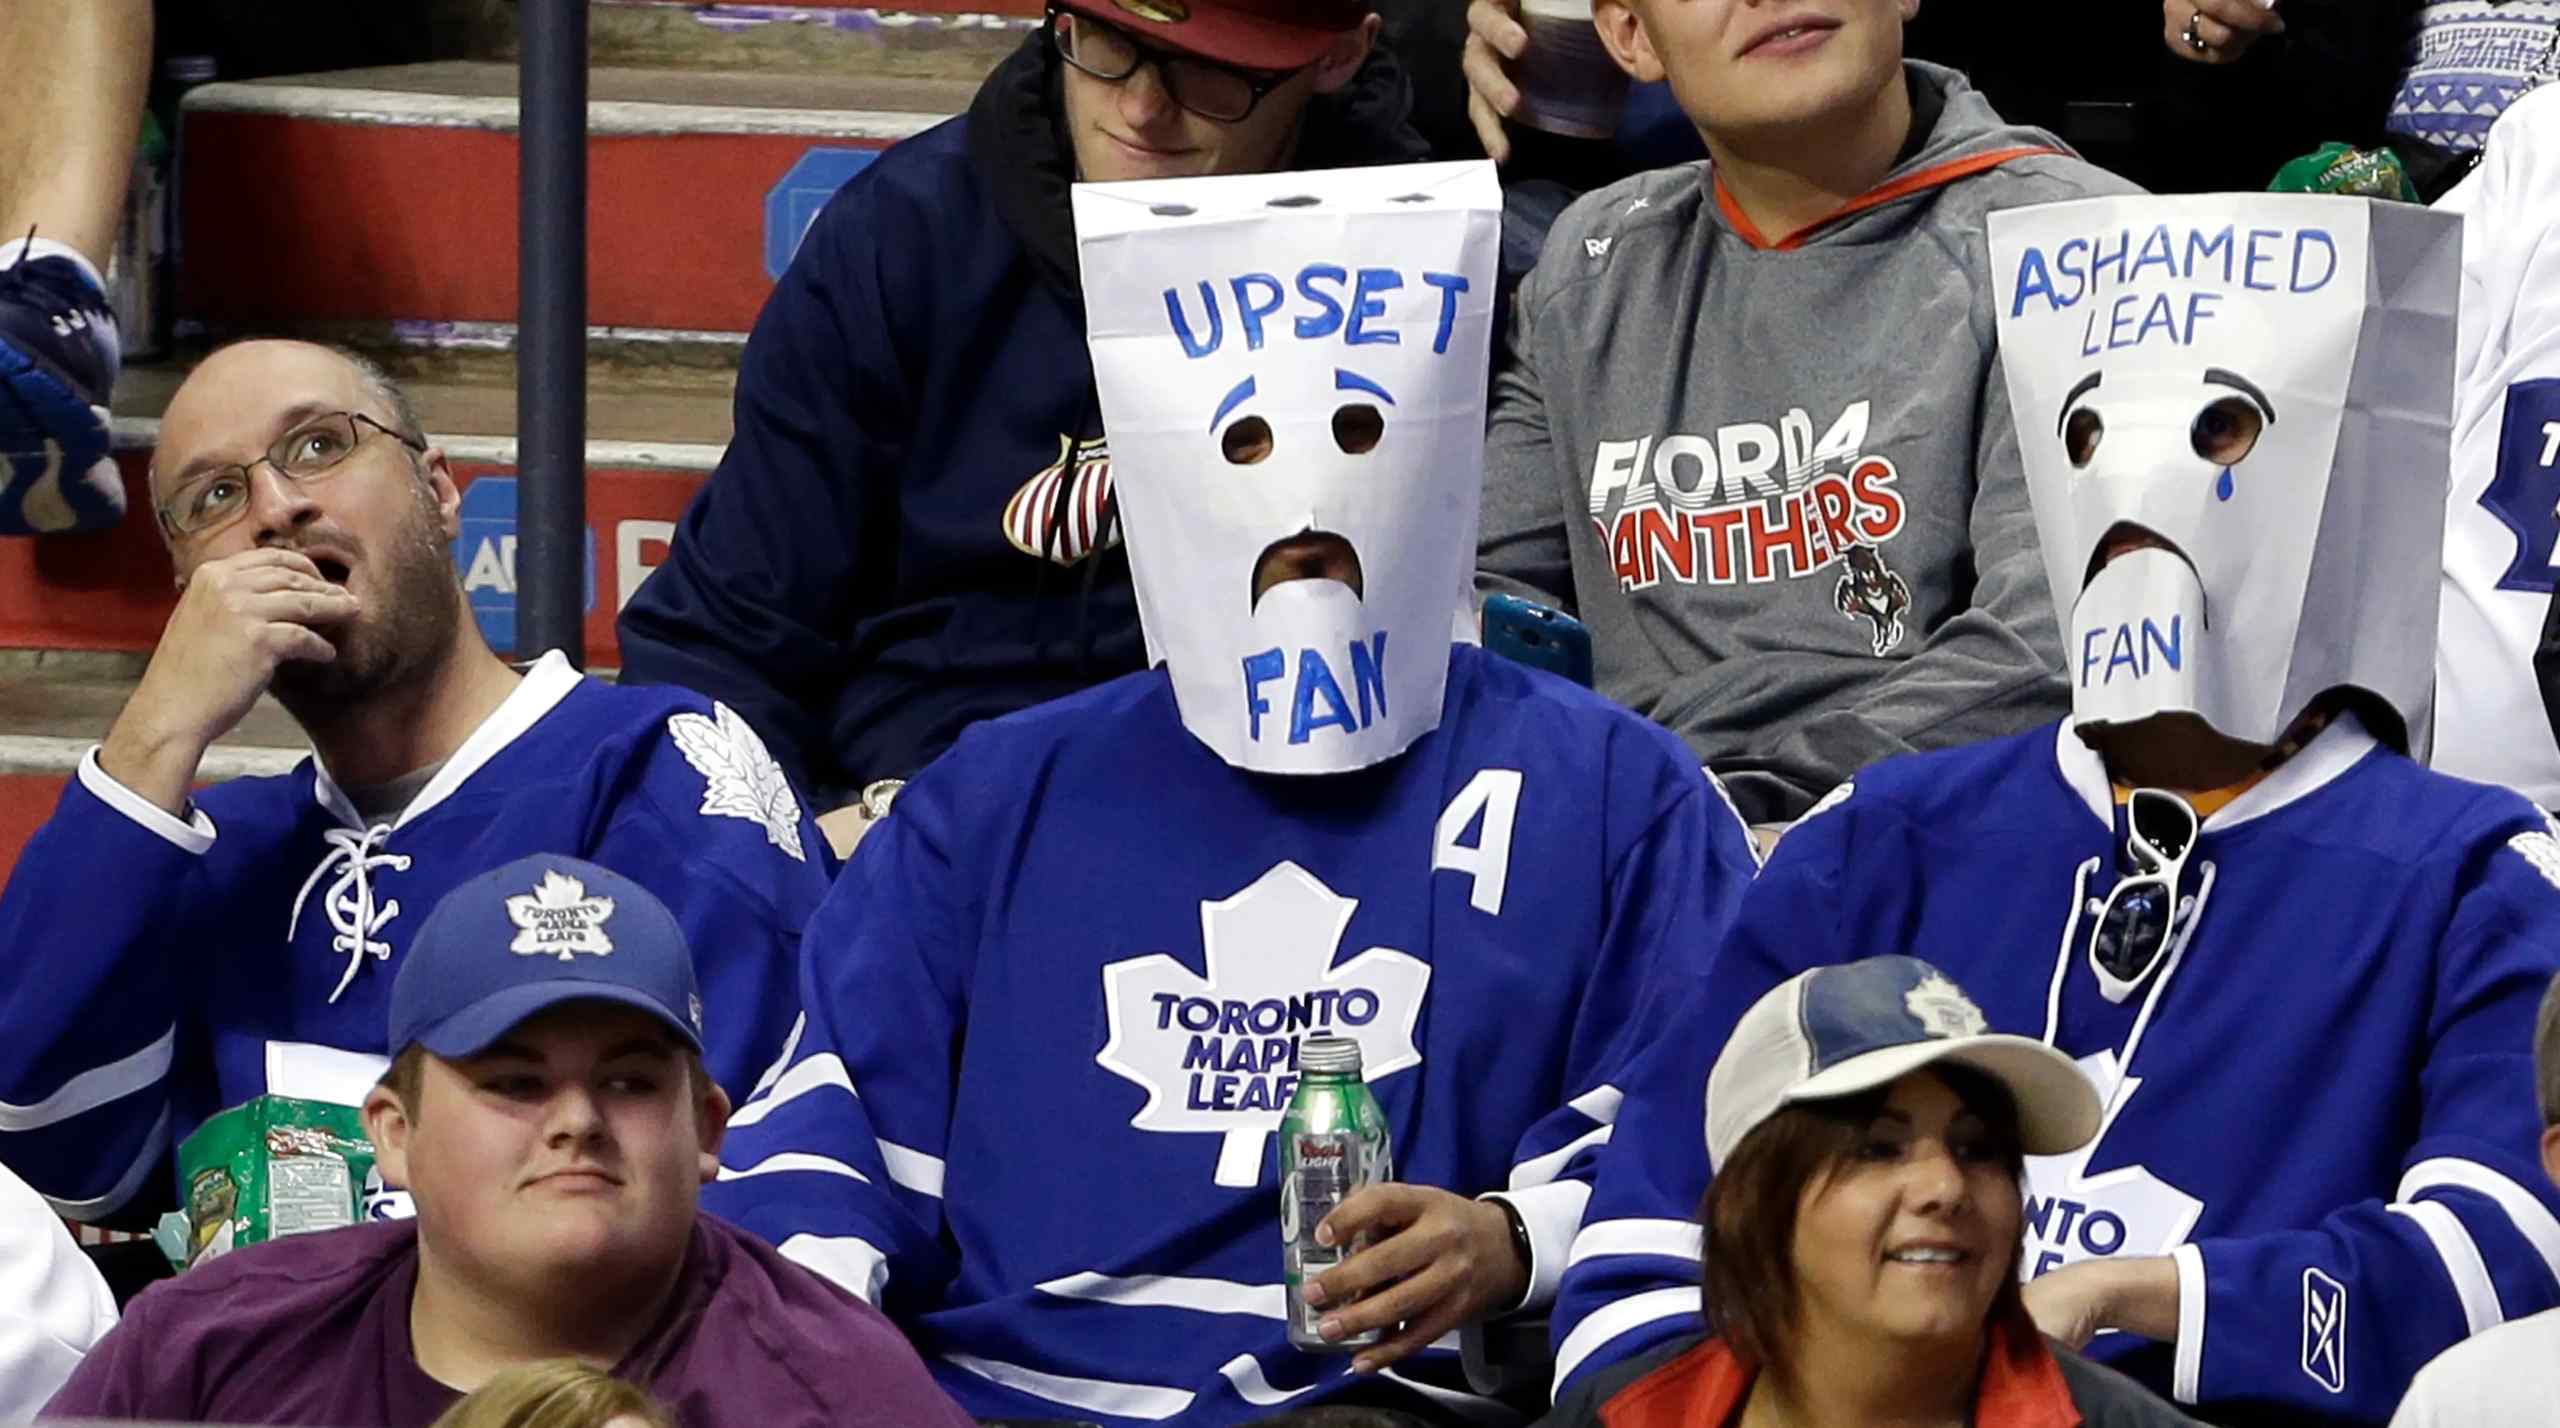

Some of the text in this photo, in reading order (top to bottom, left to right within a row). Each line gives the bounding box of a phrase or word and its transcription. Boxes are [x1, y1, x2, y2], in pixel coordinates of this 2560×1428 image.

[1163, 262, 1470, 359] UPSET
[2011, 224, 2337, 318] ASHAMED
[2082, 292, 2224, 357] LEAF
[1593, 455, 1906, 594] ANTHERS
[1241, 630, 1388, 745] FAN
[2081, 613, 2182, 688] FAN
[1431, 768, 1523, 916] A
[1152, 988, 1380, 1036] TORONTO
[1187, 1074, 1298, 1111] LEAF
